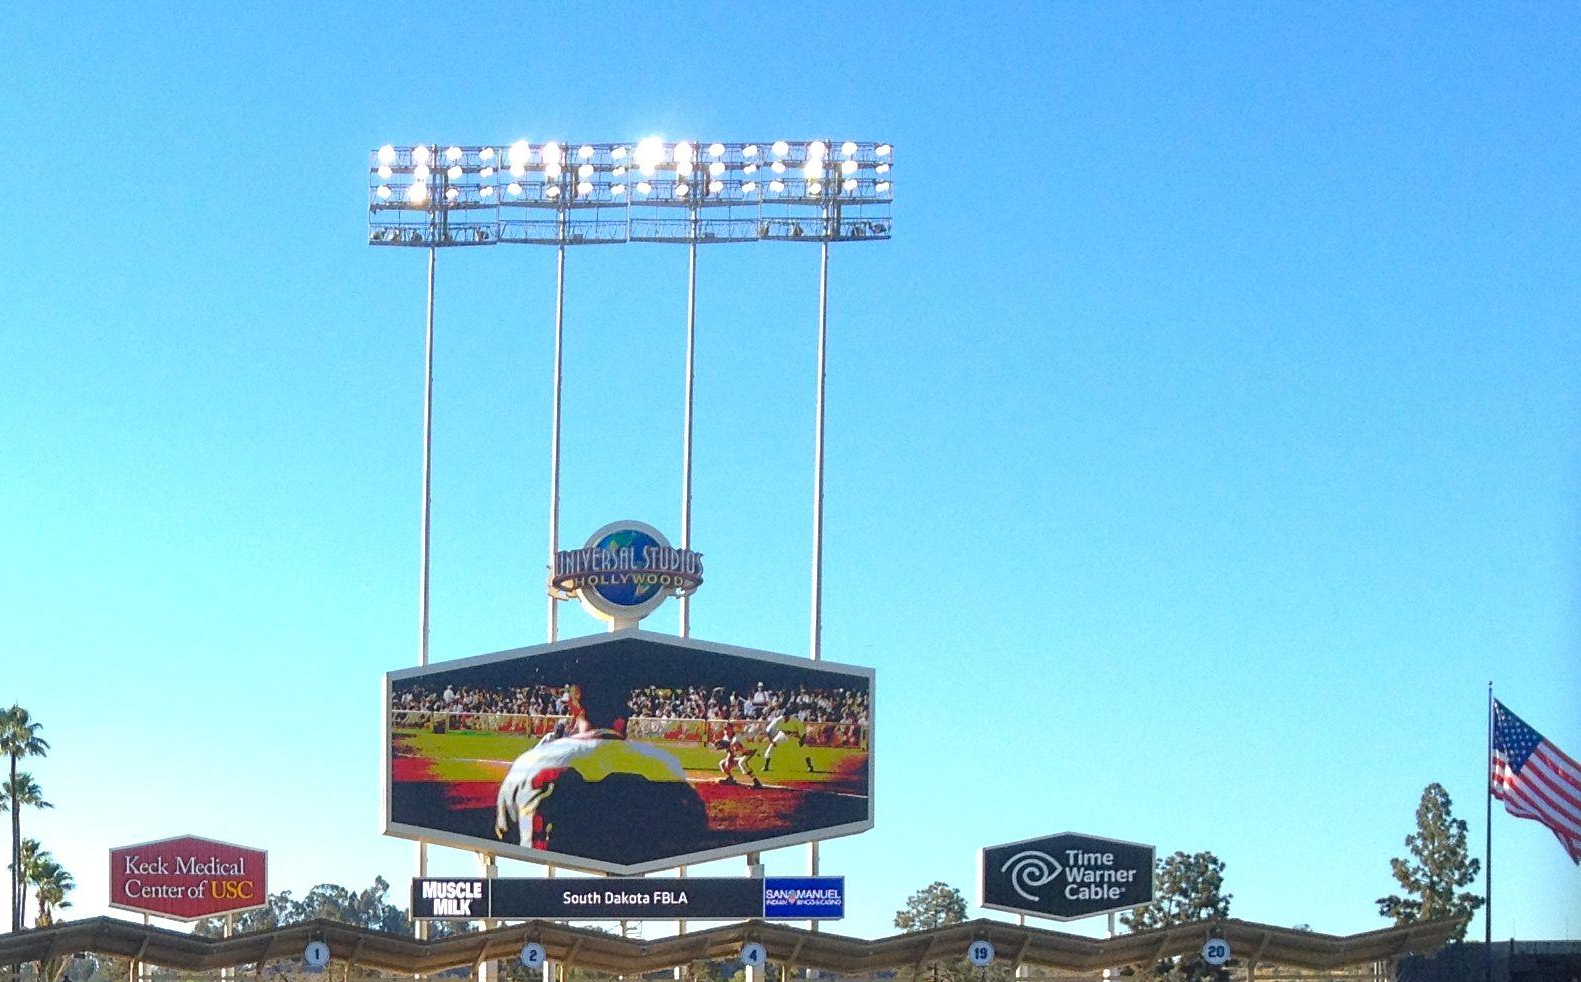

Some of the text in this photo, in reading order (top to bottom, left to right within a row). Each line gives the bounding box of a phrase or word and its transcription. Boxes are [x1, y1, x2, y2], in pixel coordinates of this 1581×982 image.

[555, 545, 703, 577] UNIVERSAL STUDIOS
[575, 574, 684, 586] HOLLYWOOD
[1065, 850, 1114, 866] Time
[125, 855, 246, 876] Keck Medical
[1065, 867, 1137, 883] Warner
[125, 879, 253, 899] Center of USC
[422, 882, 482, 899] MUSCLE
[766, 889, 841, 898] SAN MANUEL
[563, 891, 688, 904] South Dakota FBLA
[433, 899, 473, 916] MILK
[530, 949, 537, 961] 2
[749, 949, 757, 961] 4
[974, 947, 988, 959] 19
[1208, 946, 1225, 957] 20
